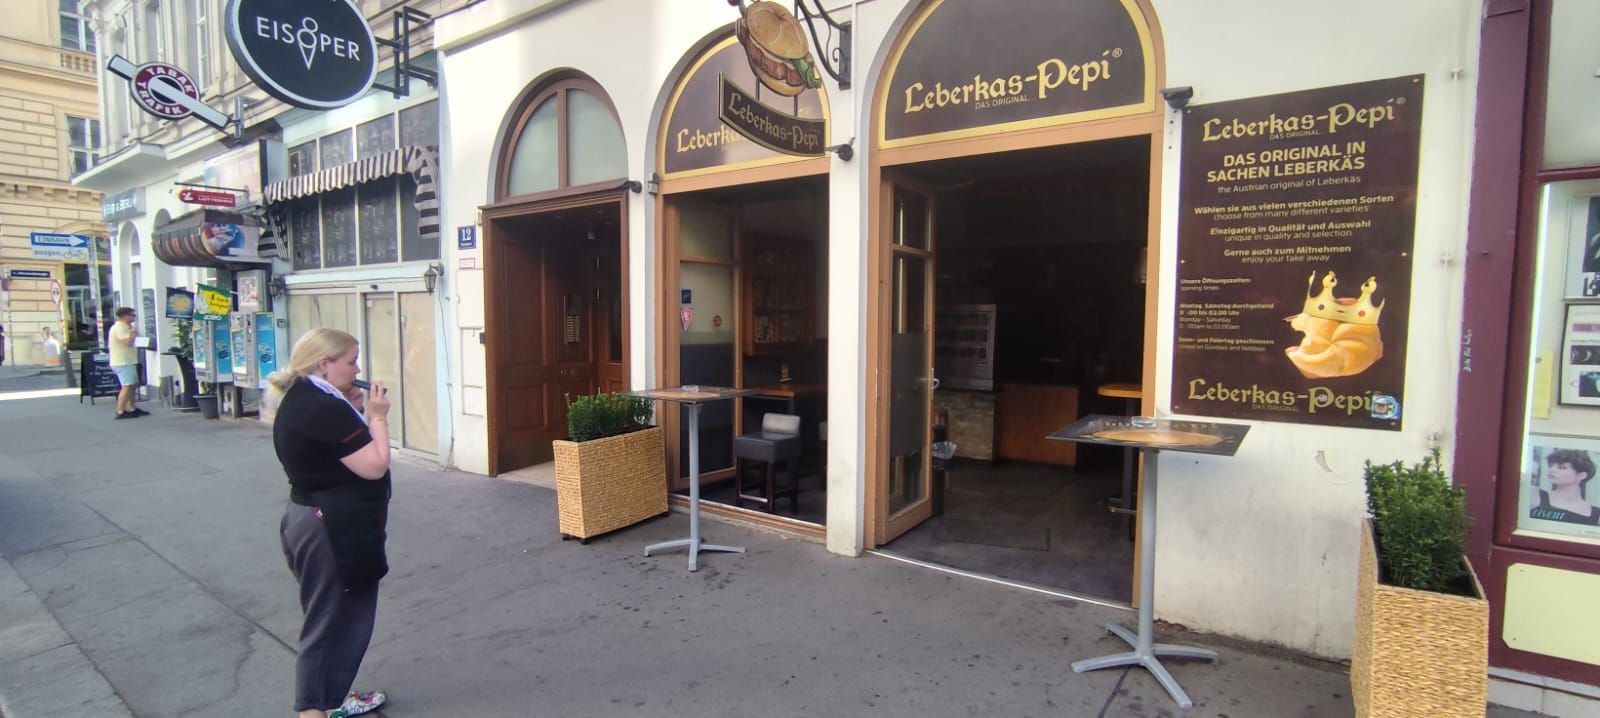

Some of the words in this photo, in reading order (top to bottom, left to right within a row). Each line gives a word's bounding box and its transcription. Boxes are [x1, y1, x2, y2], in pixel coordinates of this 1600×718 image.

[145, 66, 195, 95] TABAK
[136, 81, 183, 114] TRAFIK
[975, 101, 991, 109] DAS
[676, 124, 743, 153] Leberka
[1270, 133, 1285, 141] DAS
[1223, 152, 1256, 167] DAS
[1259, 143, 1342, 164] ORIGINAL
[1346, 140, 1366, 155] IN
[1206, 165, 1270, 183] SACHEN
[1274, 155, 1365, 177] LEBERKÄS
[1232, 182, 1269, 193] Austrian
[1270, 180, 1304, 191] original
[1305, 178, 1315, 187] of
[1317, 175, 1361, 186] Leberkäs
[1194, 206, 1225, 215] Wählen
[1227, 204, 1239, 212] sie
[1241, 204, 1257, 212] aus
[1287, 198, 1358, 208] verschiedenen
[1359, 195, 1394, 204] Sorten
[1213, 212, 1242, 220] choose
[1243, 211, 1264, 219] from
[1264, 210, 1289, 218] many
[1290, 206, 1329, 216] different
[1329, 204, 1369, 214] varieties
[462, 227, 472, 241] 12
[1209, 226, 1257, 236] Einzigartig
[1268, 222, 1306, 232] Qualität
[1307, 222, 1326, 230] und
[1327, 219, 1371, 229] Auswahl
[1224, 235, 1253, 243] unique
[1263, 232, 1292, 241] quality
[1293, 231, 1310, 239] and
[1311, 229, 1352, 239] selection
[1223, 249, 1250, 257] Gerne
[1251, 248, 1273, 256] auch
[1296, 245, 1352, 255] Mitnehmen
[1241, 256, 1264, 264] enjoy
[1265, 255, 1284, 263] your
[1285, 254, 1305, 262] take
[1306, 254, 1330, 263] away
